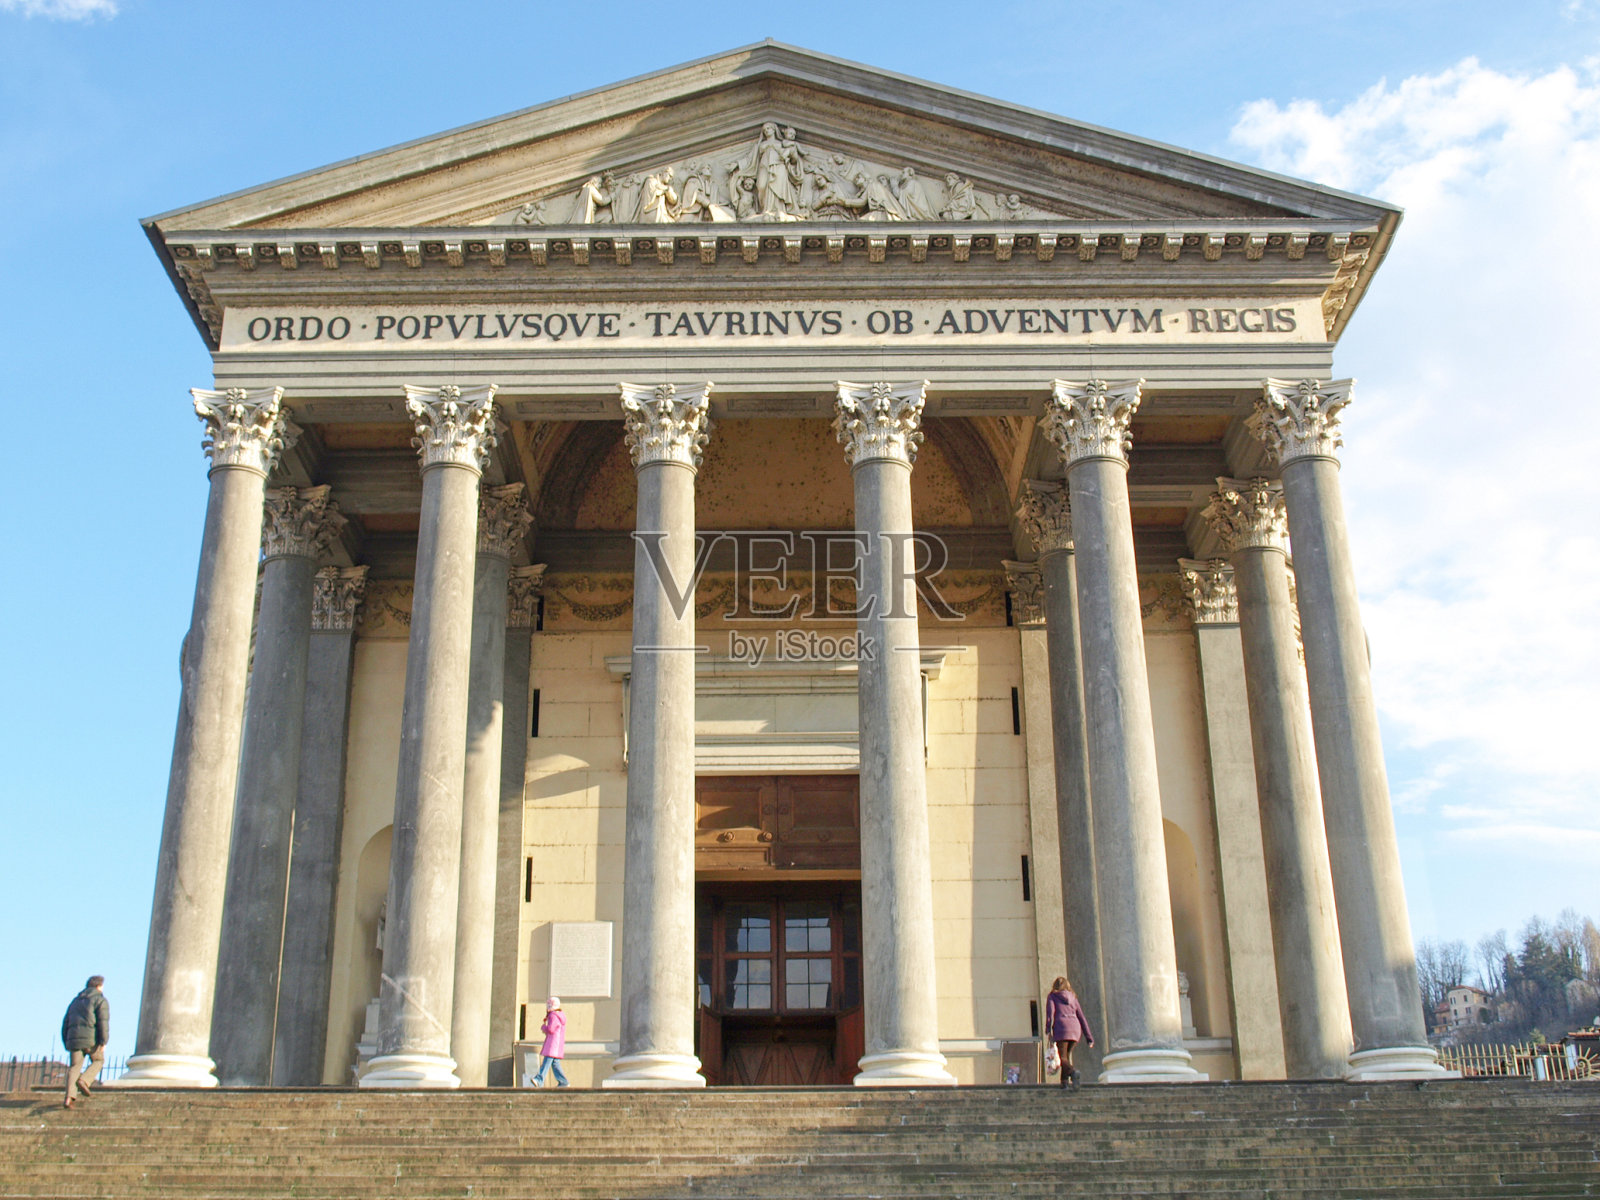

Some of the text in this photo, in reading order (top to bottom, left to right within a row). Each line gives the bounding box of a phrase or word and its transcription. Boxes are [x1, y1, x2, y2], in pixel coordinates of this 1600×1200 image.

[247, 308, 1297, 342] ORDO POPVLVSQVE TAVRINVS OB ADVENTVM REGIS
